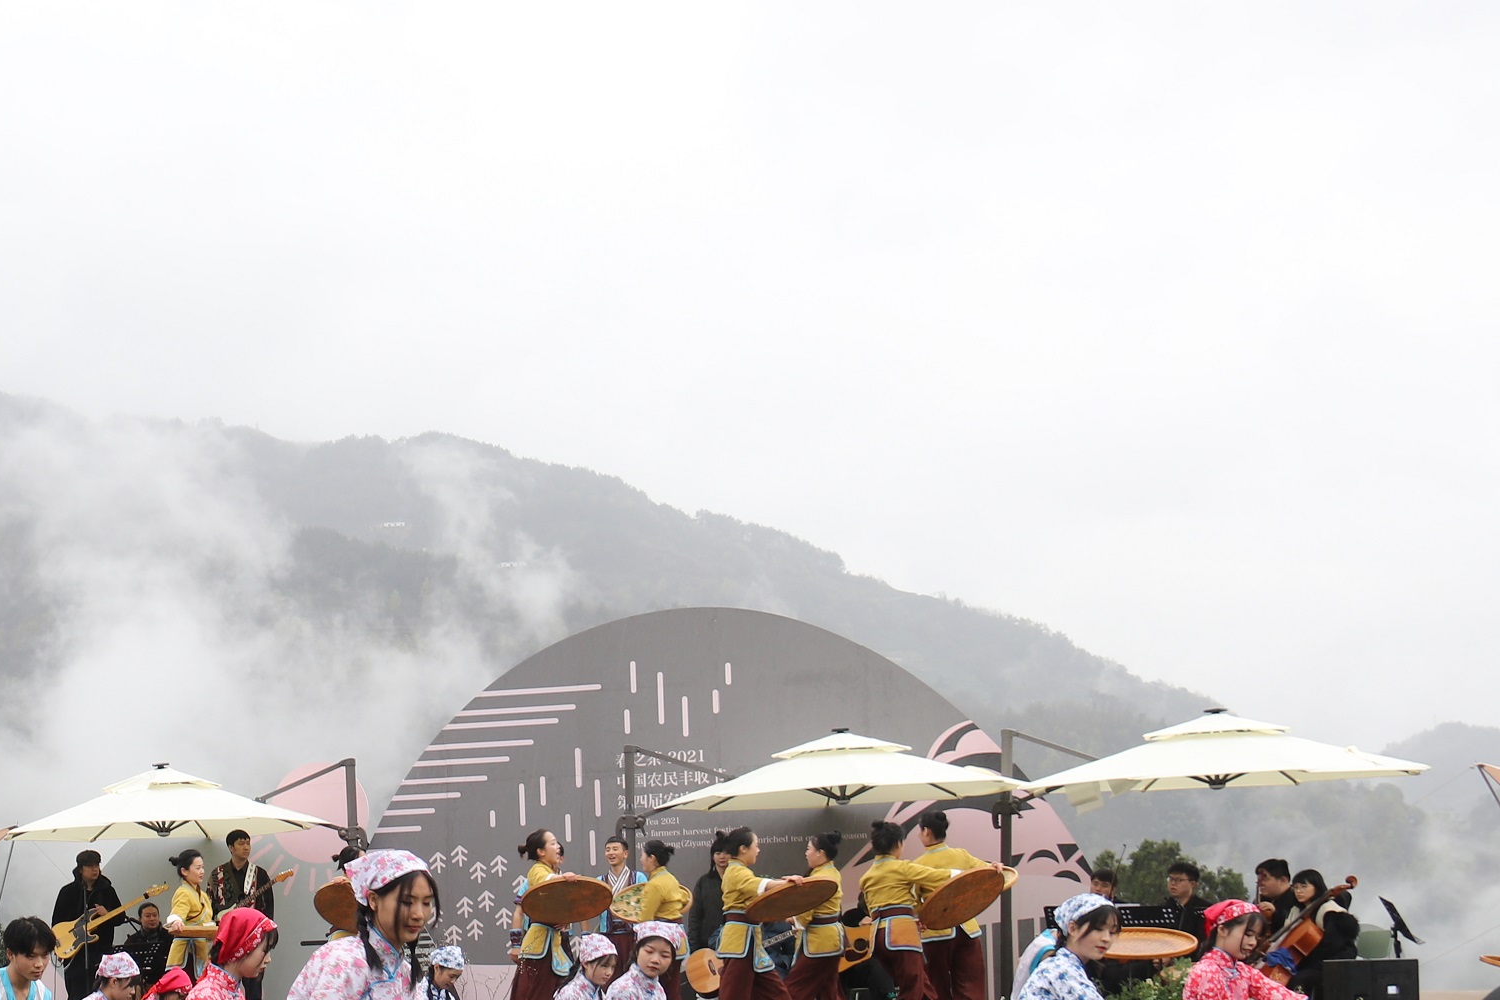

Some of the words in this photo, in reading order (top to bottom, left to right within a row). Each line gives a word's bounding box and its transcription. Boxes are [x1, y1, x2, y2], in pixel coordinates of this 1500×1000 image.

[660, 817, 680, 825] 2021
[650, 829, 680, 838] farmers
[682, 827, 712, 836] harvest
[757, 835, 789, 844] nriched
